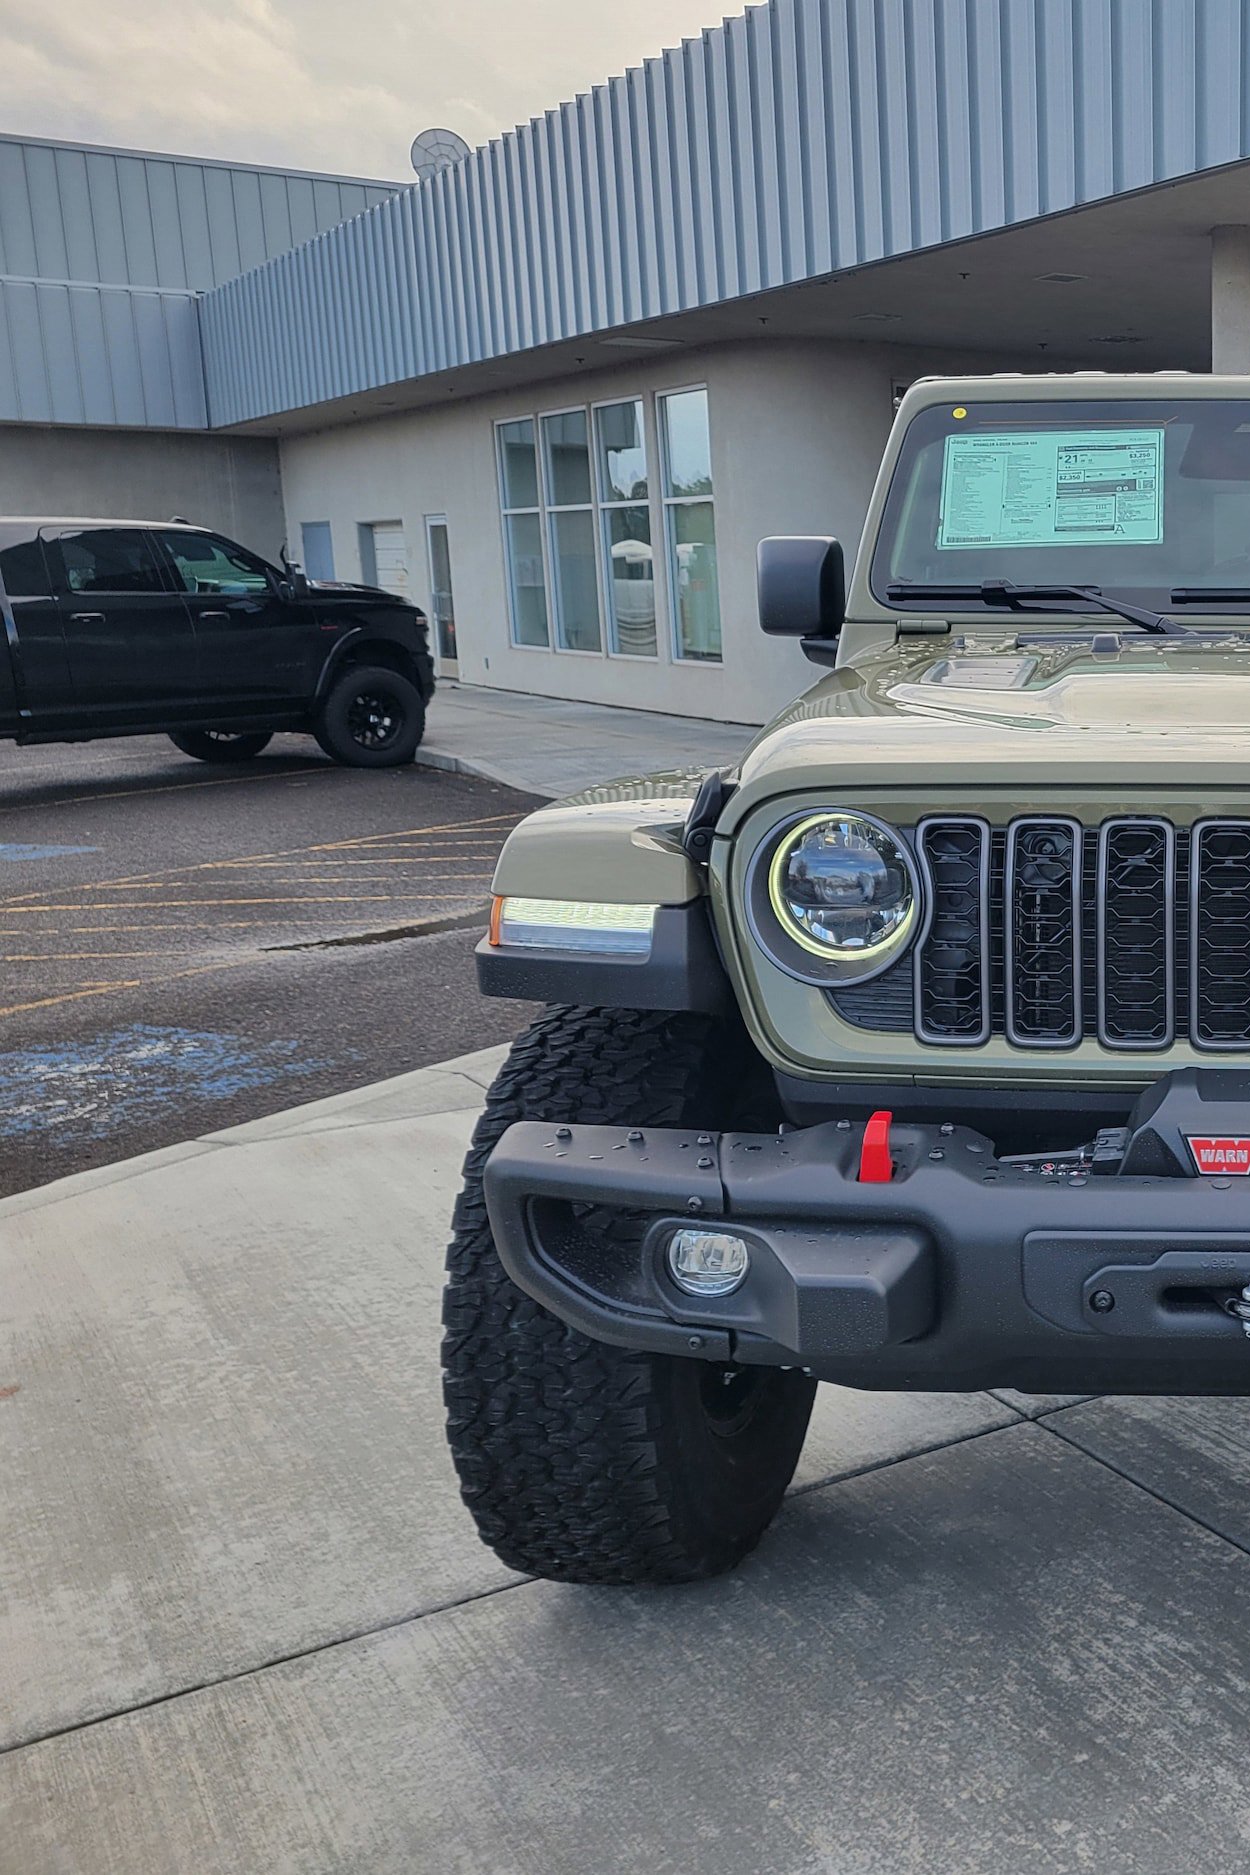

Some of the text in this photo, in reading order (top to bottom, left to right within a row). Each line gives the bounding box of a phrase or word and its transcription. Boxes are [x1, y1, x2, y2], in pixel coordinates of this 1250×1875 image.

[1064, 454, 1078, 464] 21
[1114, 523, 1126, 535] A
[1200, 1148, 1248, 1163] WARN
